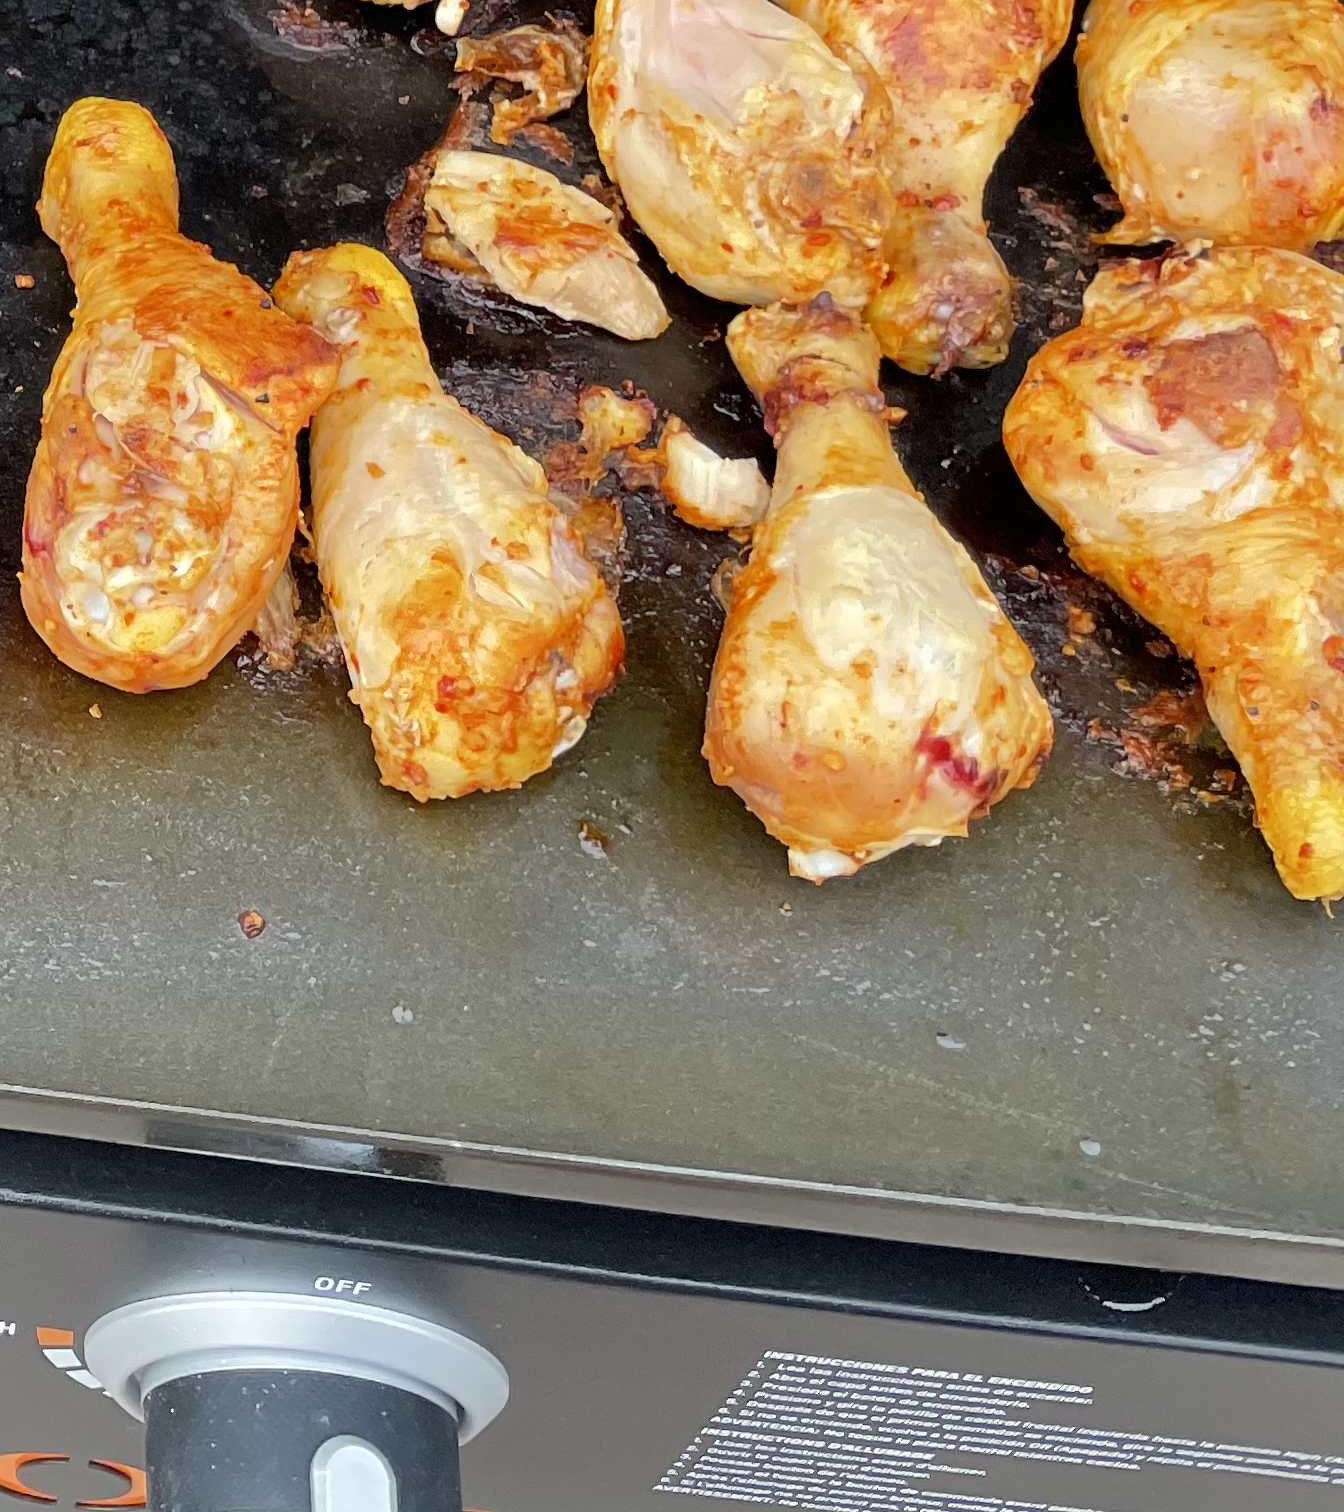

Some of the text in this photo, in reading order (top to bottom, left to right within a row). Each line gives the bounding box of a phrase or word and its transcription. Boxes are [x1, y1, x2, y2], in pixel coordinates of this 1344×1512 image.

[315, 1276, 372, 1296] OFF
[764, 1351, 1093, 1393] INSTRUCCIONES PARA EL ENCENDIDO
